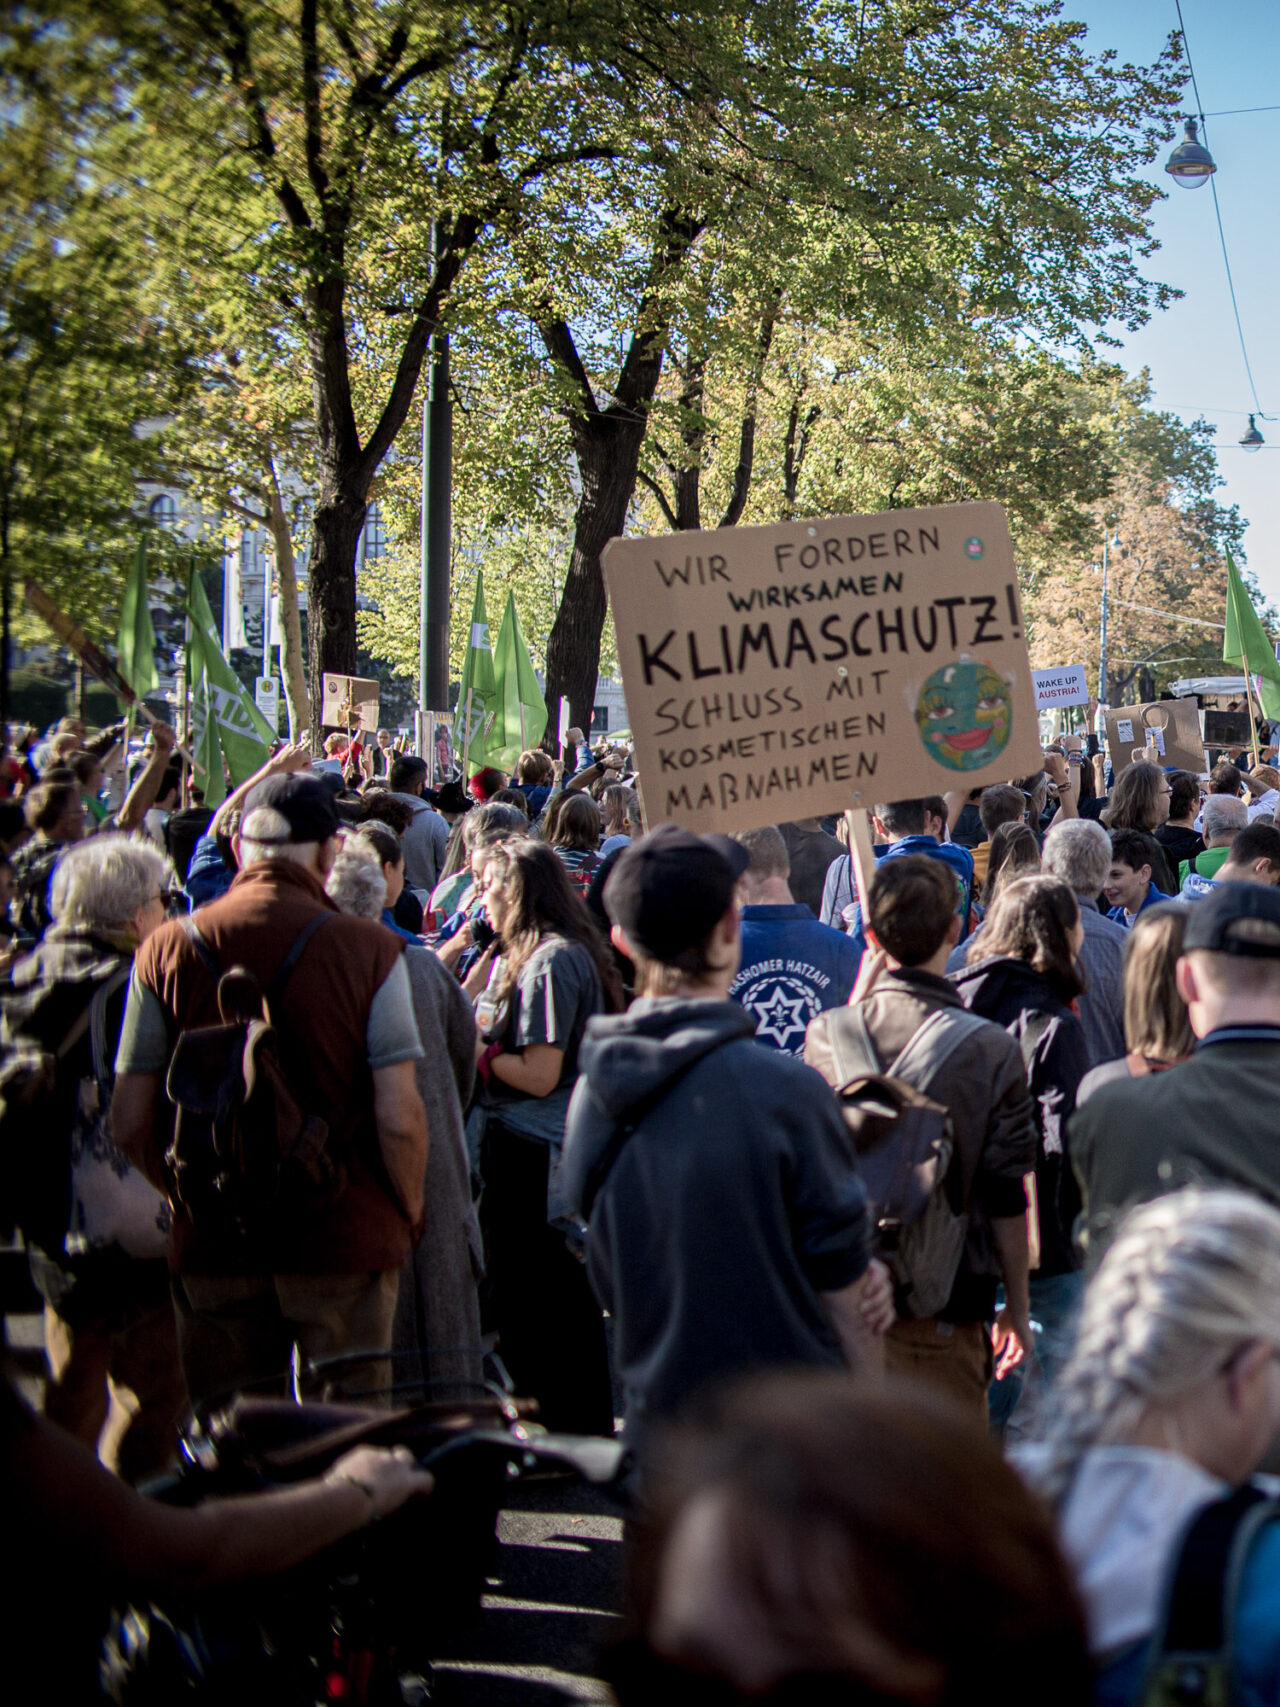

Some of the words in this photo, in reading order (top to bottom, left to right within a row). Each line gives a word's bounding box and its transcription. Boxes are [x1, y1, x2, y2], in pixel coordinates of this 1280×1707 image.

[655, 554, 732, 587] WIR
[775, 526, 940, 573] FORDERN
[727, 571, 905, 613] WIRKSAMEN
[636, 583, 1022, 686] KLIMASCHUTZ!
[654, 686, 803, 736] SCHLUSS
[826, 669, 890, 702] MIT
[1037, 678, 1063, 689] WAKE
[1065, 676, 1077, 685] UP
[1039, 686, 1080, 699] AUSTRIA!
[659, 711, 886, 773] KOSMETISCHEN
[665, 751, 879, 817] MAßNAHMEN
[728, 959, 783, 995] HASHOMER
[786, 959, 831, 990] HATZAIR
